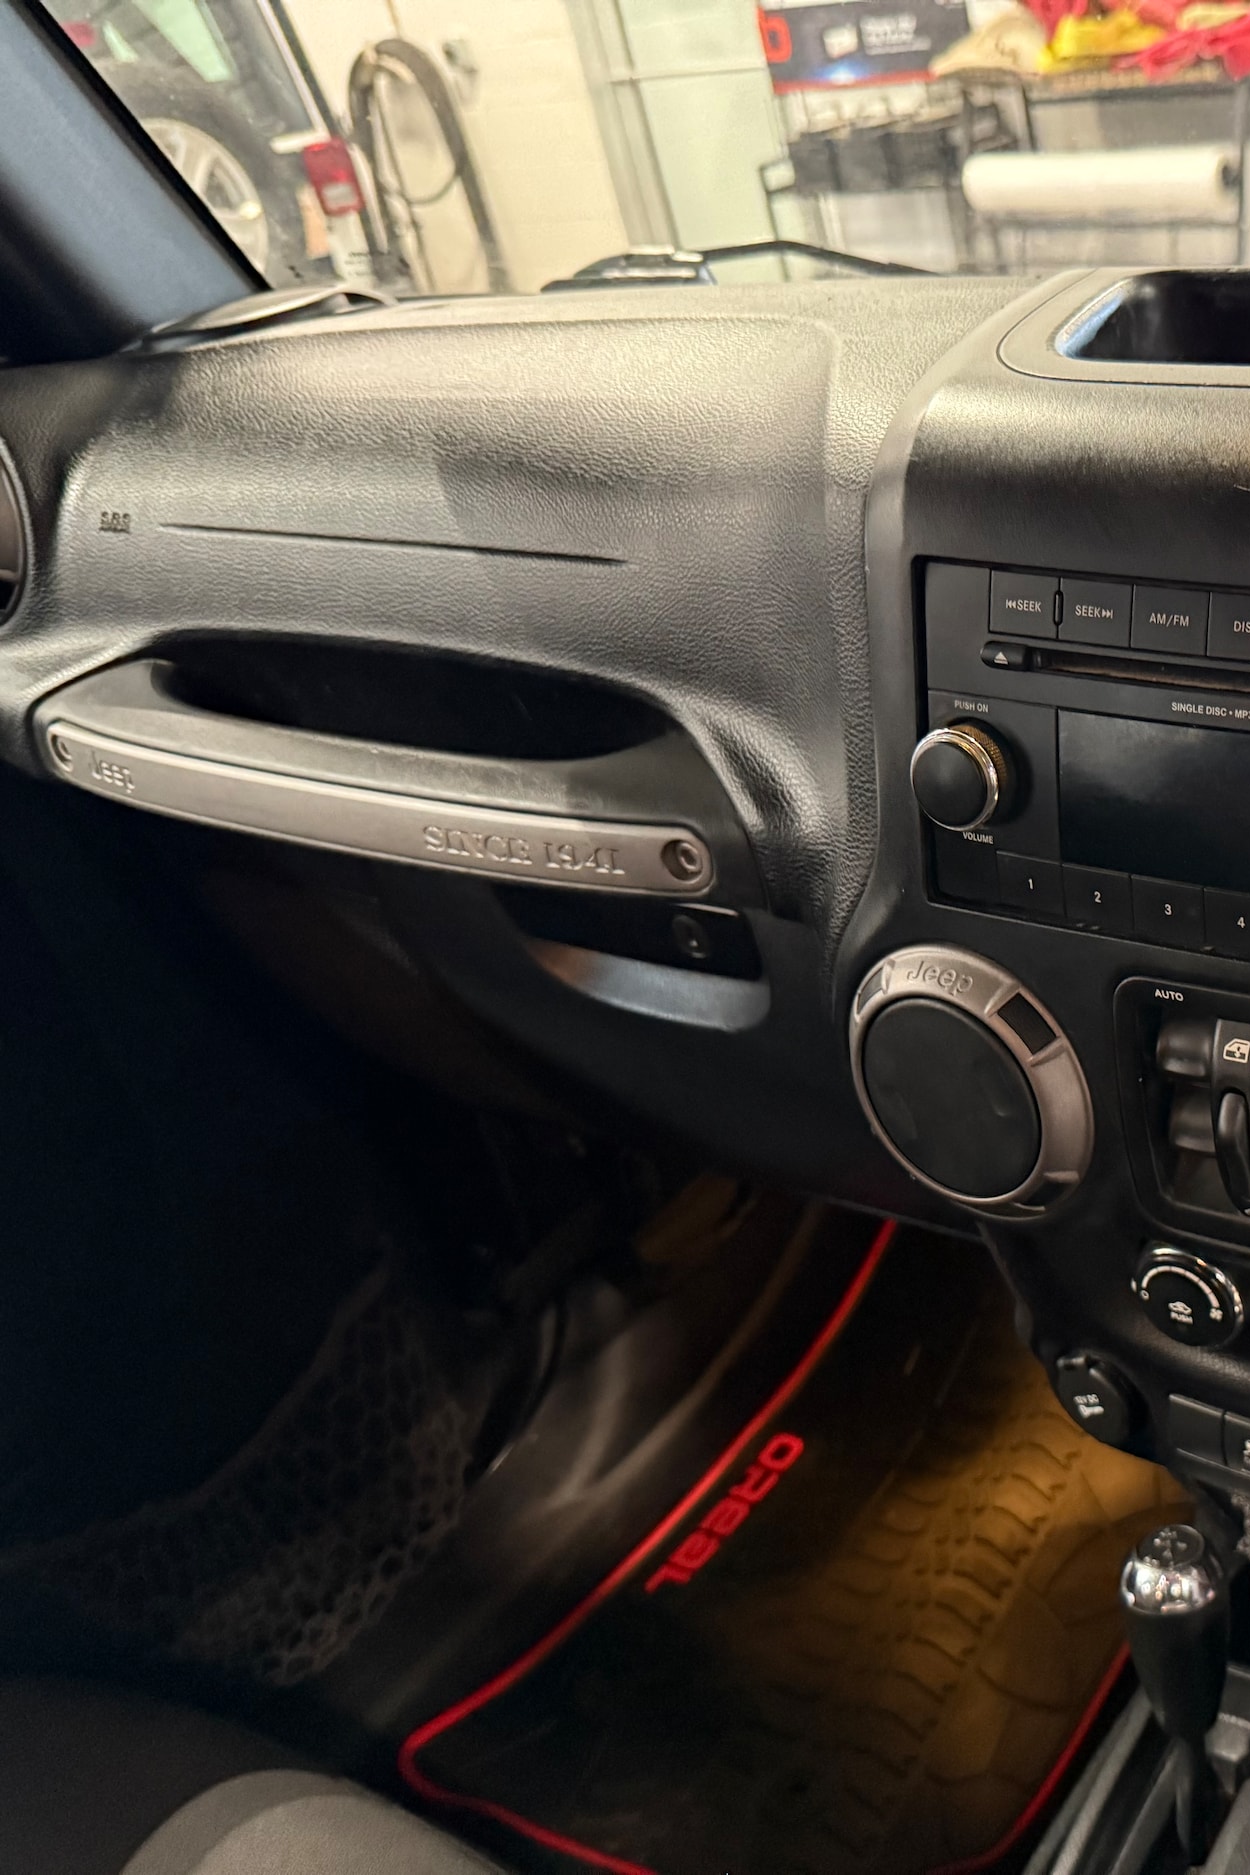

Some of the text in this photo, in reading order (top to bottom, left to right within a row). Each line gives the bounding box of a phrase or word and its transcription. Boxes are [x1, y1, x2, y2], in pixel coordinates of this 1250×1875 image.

[1016, 599, 1042, 613] SEEK
[1074, 604, 1101, 618] SEEK
[1149, 612, 1190, 627] AM/FM
[954, 699, 989, 713] PUSH ON
[1171, 701, 1204, 715] SINGLE
[1205, 705, 1227, 717] DISC
[91, 751, 135, 793] Jeep
[962, 831, 994, 845] VOLUME
[423, 826, 626, 875] SINCE 1941
[1028, 878, 1034, 890] 1
[1094, 890, 1102, 903] 2
[1164, 903, 1172, 916] 3
[1237, 916, 1246, 929] 4
[906, 960, 974, 996] Jeep
[1154, 988, 1184, 1002] AUTO
